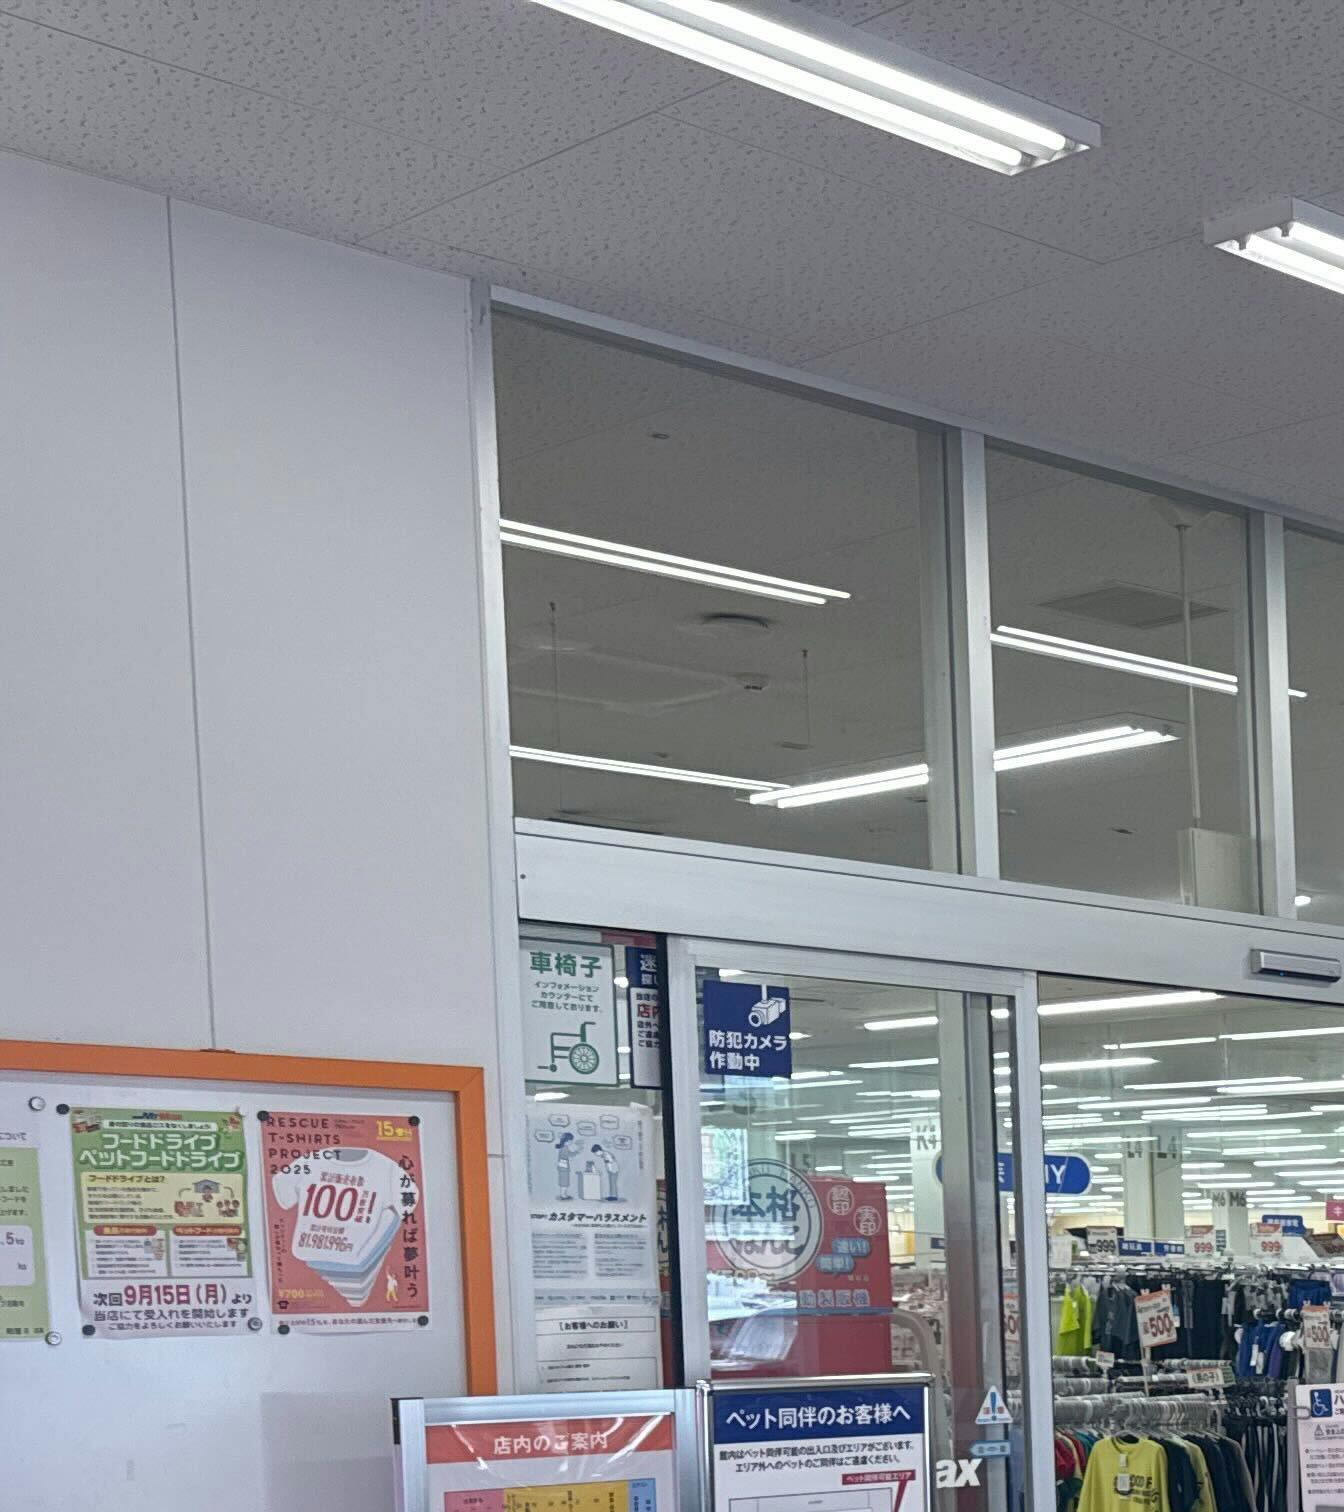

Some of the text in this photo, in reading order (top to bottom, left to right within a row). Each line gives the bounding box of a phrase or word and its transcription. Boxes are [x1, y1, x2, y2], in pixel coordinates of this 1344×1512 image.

[530, 951, 602, 978] 車椅子
[709, 1030, 787, 1052] 防犯カメラ
[709, 1051, 761, 1071] 作動中
[266, 1117, 329, 1129] RESCUE
[102, 1133, 217, 1150] フードドライブ
[268, 1132, 341, 1145] T-SHIRTS
[79, 1149, 243, 1169] ペットフードドライブ
[268, 1148, 342, 1161] PROJECT
[269, 1163, 312, 1175] 2025
[303, 1183, 359, 1222] 100
[400, 1155, 420, 1298] 心が募れば夢叶う
[548, 1211, 647, 1224] カスタマーハラスメント
[726, 1404, 911, 1430] ペット同伴のお客様へ
[493, 1430, 609, 1455] 店内のご案内
